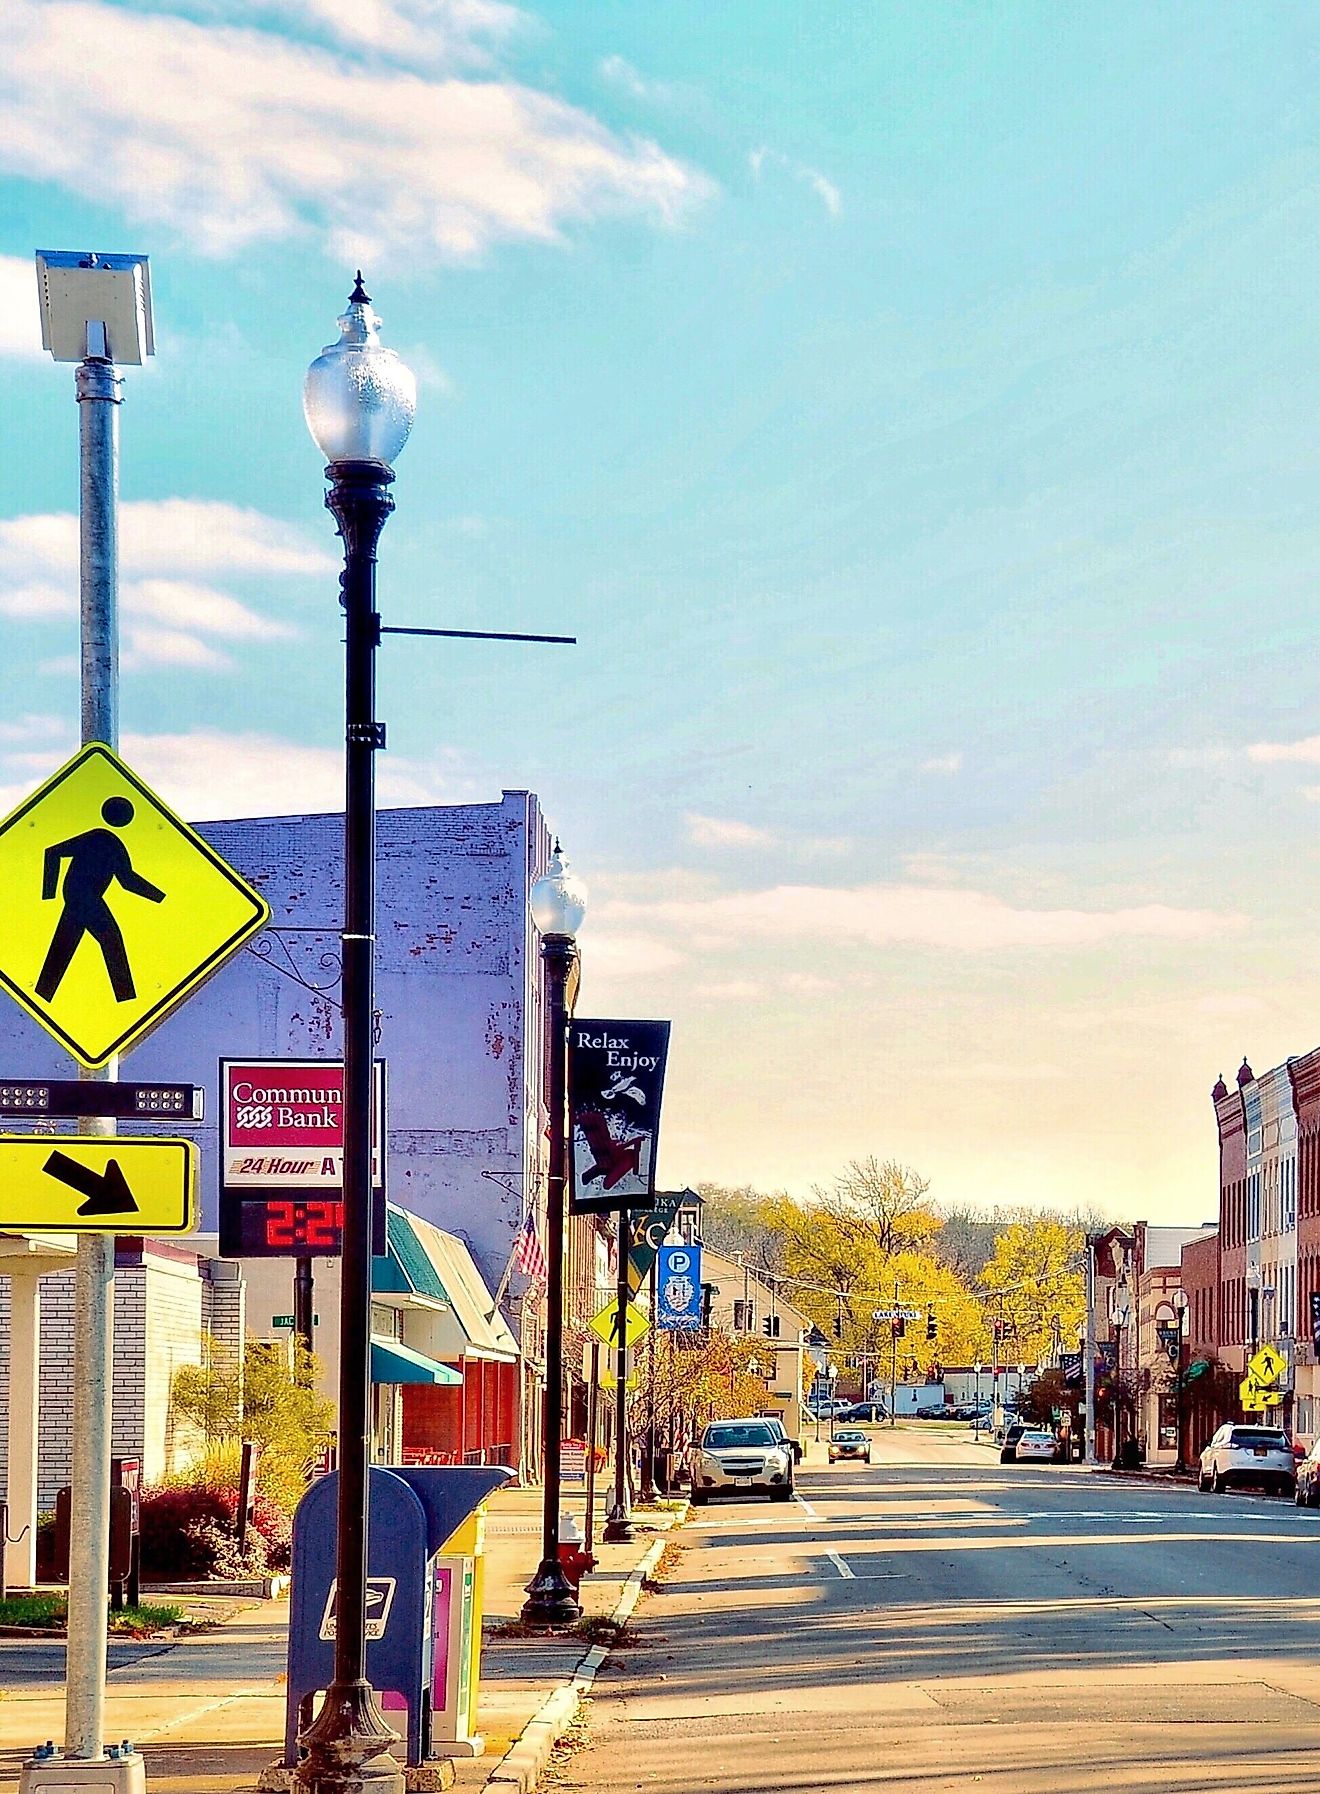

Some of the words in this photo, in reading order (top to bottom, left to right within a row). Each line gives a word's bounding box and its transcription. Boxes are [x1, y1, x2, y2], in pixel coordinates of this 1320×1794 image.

[577, 1032, 630, 1050] Relax
[606, 1051, 660, 1071] Enjoy
[232, 1082, 343, 1104] Commun
[277, 1106, 339, 1128] Bank
[240, 1158, 264, 1174] 24
[266, 1158, 314, 1174] Hour
[673, 1255, 686, 1270] P
[280, 1317, 295, 1326] JAC
